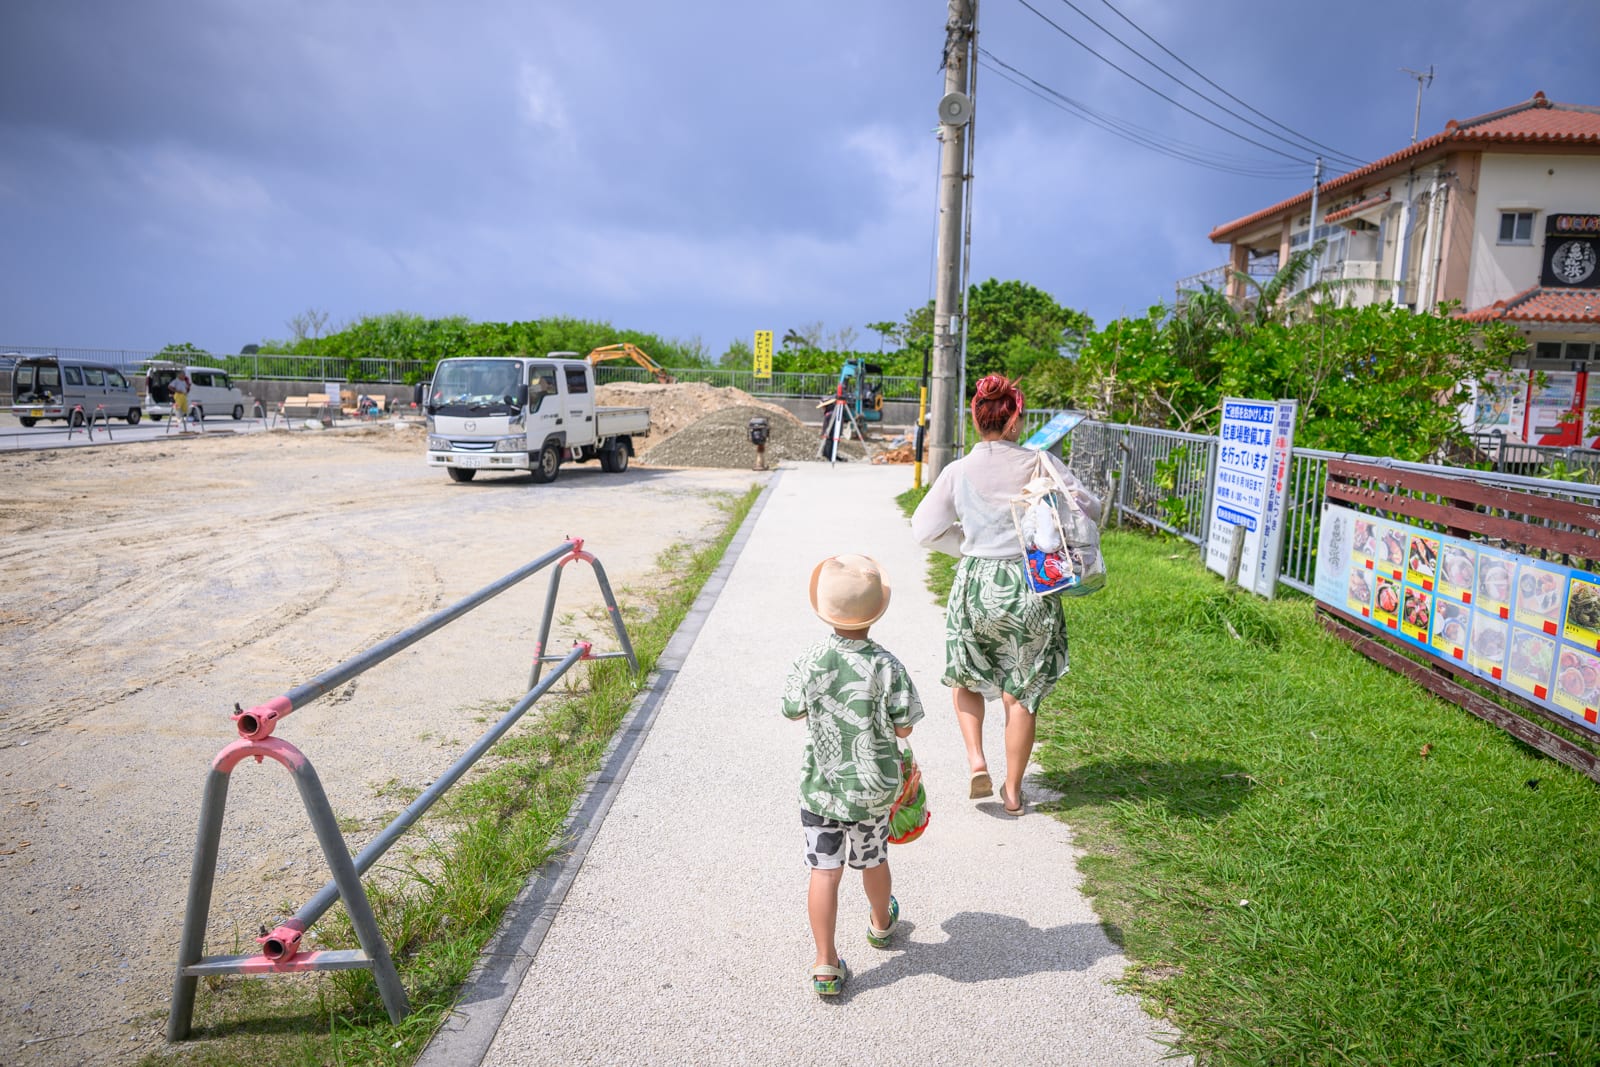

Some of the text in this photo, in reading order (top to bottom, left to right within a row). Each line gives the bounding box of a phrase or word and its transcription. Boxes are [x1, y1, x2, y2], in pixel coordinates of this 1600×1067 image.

[1223, 424, 1272, 447] 駐車場整備工事
[1222, 446, 1268, 471] を行っています
